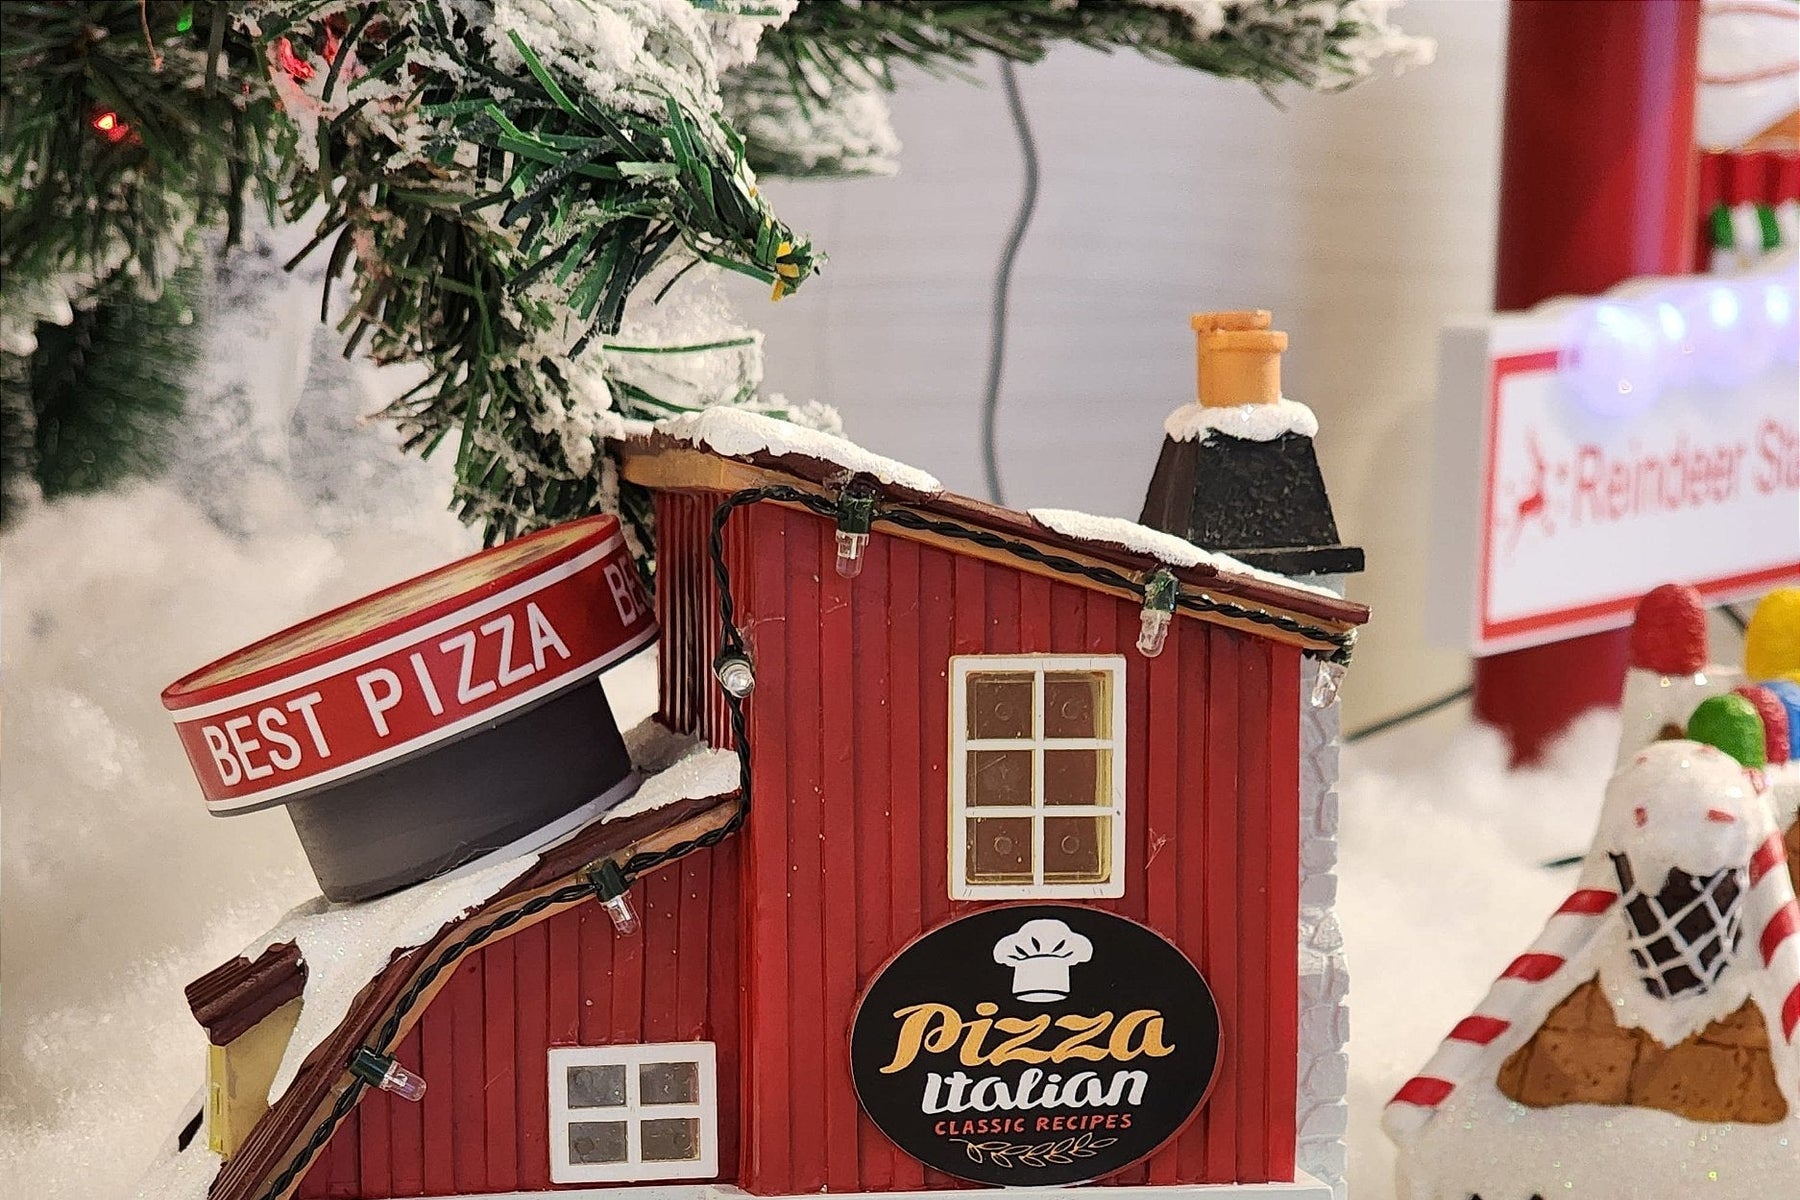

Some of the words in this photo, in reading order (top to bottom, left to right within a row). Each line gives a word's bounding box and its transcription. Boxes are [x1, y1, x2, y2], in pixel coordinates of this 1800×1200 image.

[1570, 430, 1746, 527] Reindeer
[202, 691, 331, 787] BEST
[356, 601, 571, 738] PIZZA
[880, 1002, 1176, 1074] Pizza
[921, 1068, 1149, 1115] Italian
[934, 1117, 1026, 1136] CLASSIC
[1035, 1112, 1133, 1132] RECIPES
